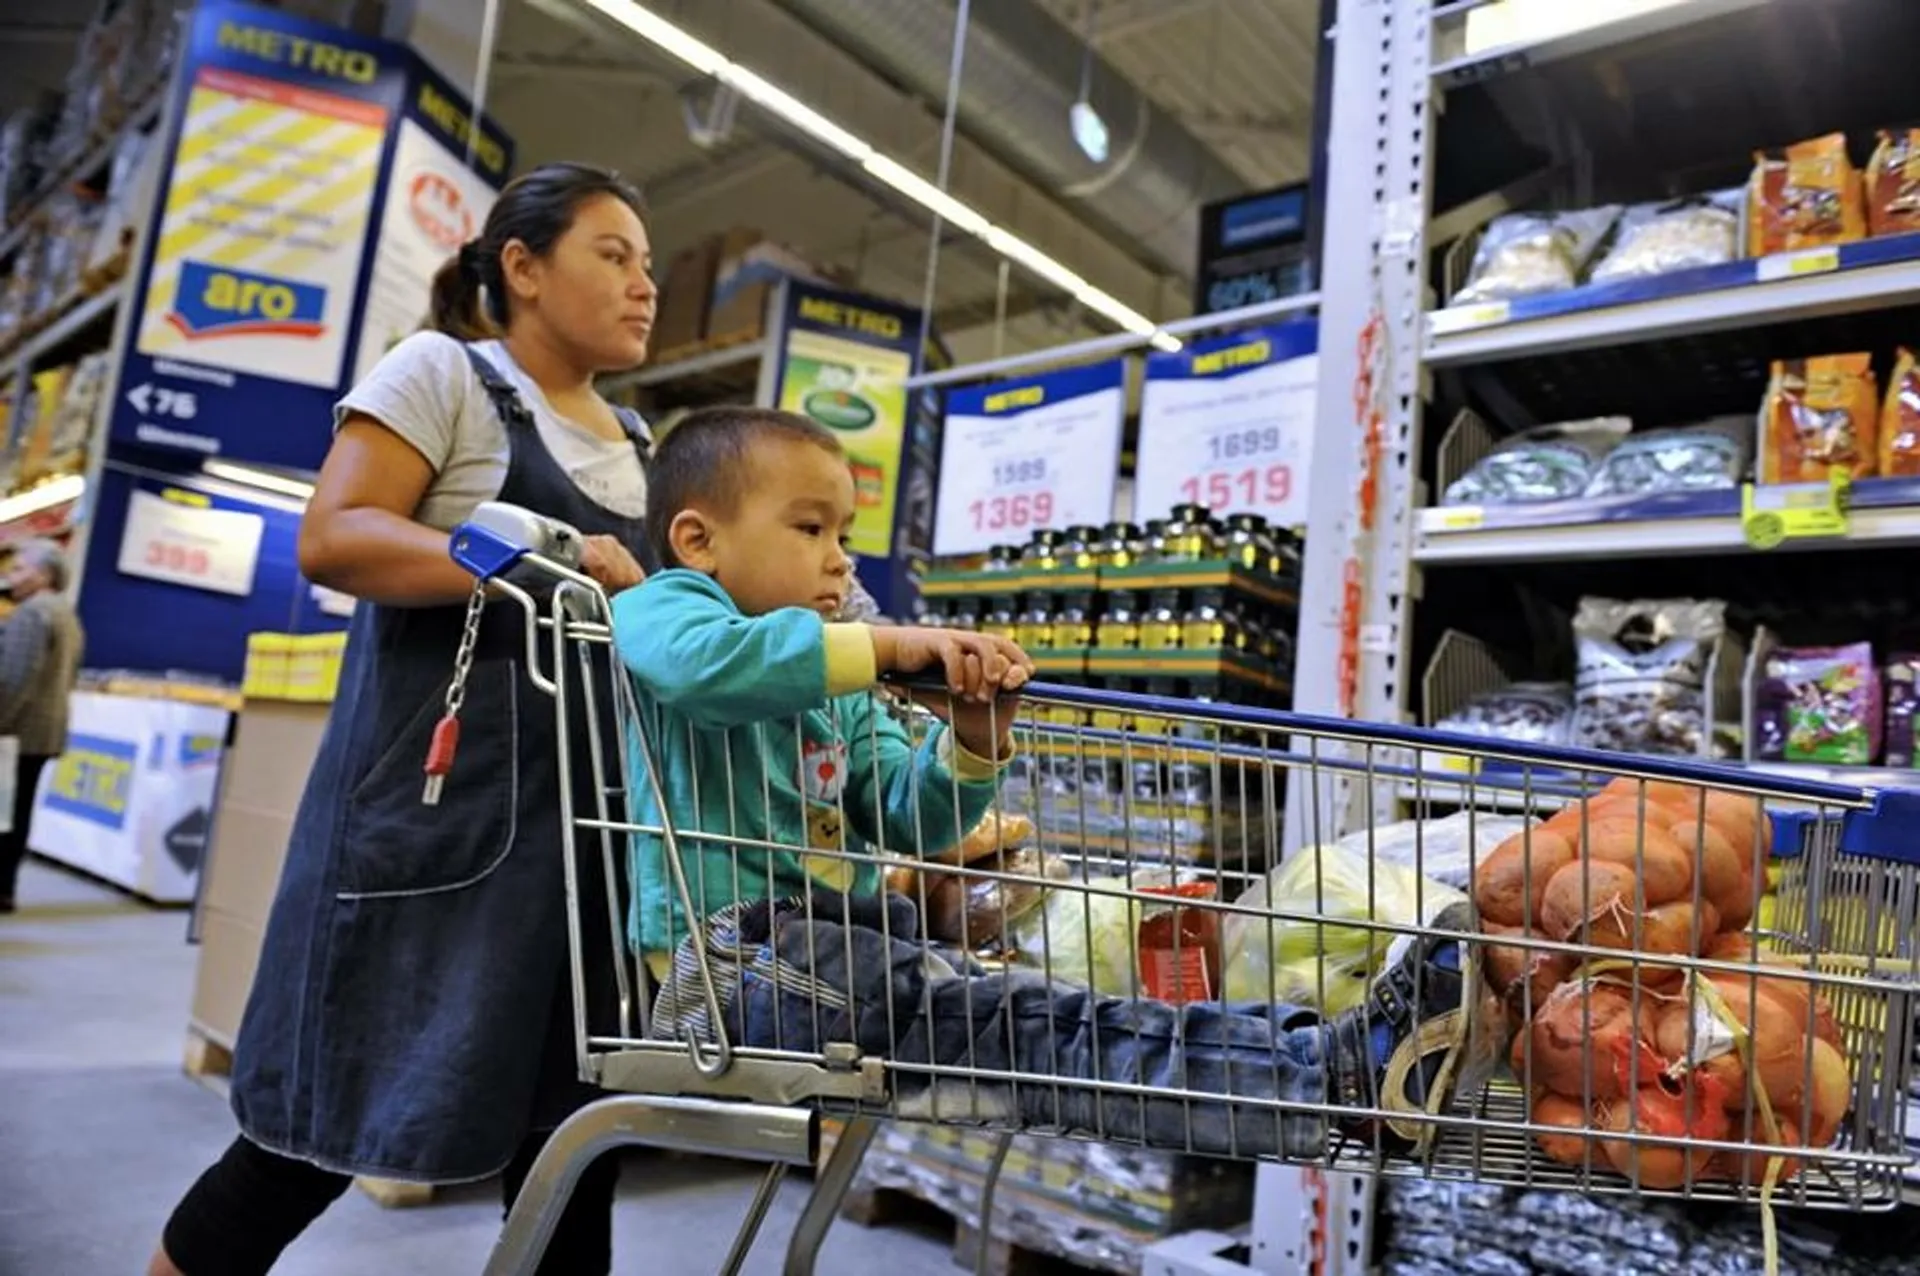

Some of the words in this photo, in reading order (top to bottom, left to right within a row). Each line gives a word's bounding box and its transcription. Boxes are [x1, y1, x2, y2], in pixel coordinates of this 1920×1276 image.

[218, 22, 376, 84] METRO
[203, 273, 296, 320] aro
[800, 298, 901, 339] METRO
[1192, 340, 1269, 374] METRO
[1208, 426, 1280, 459] 1699
[1181, 464, 1292, 511] 1519
[968, 492, 1053, 532] 1369
